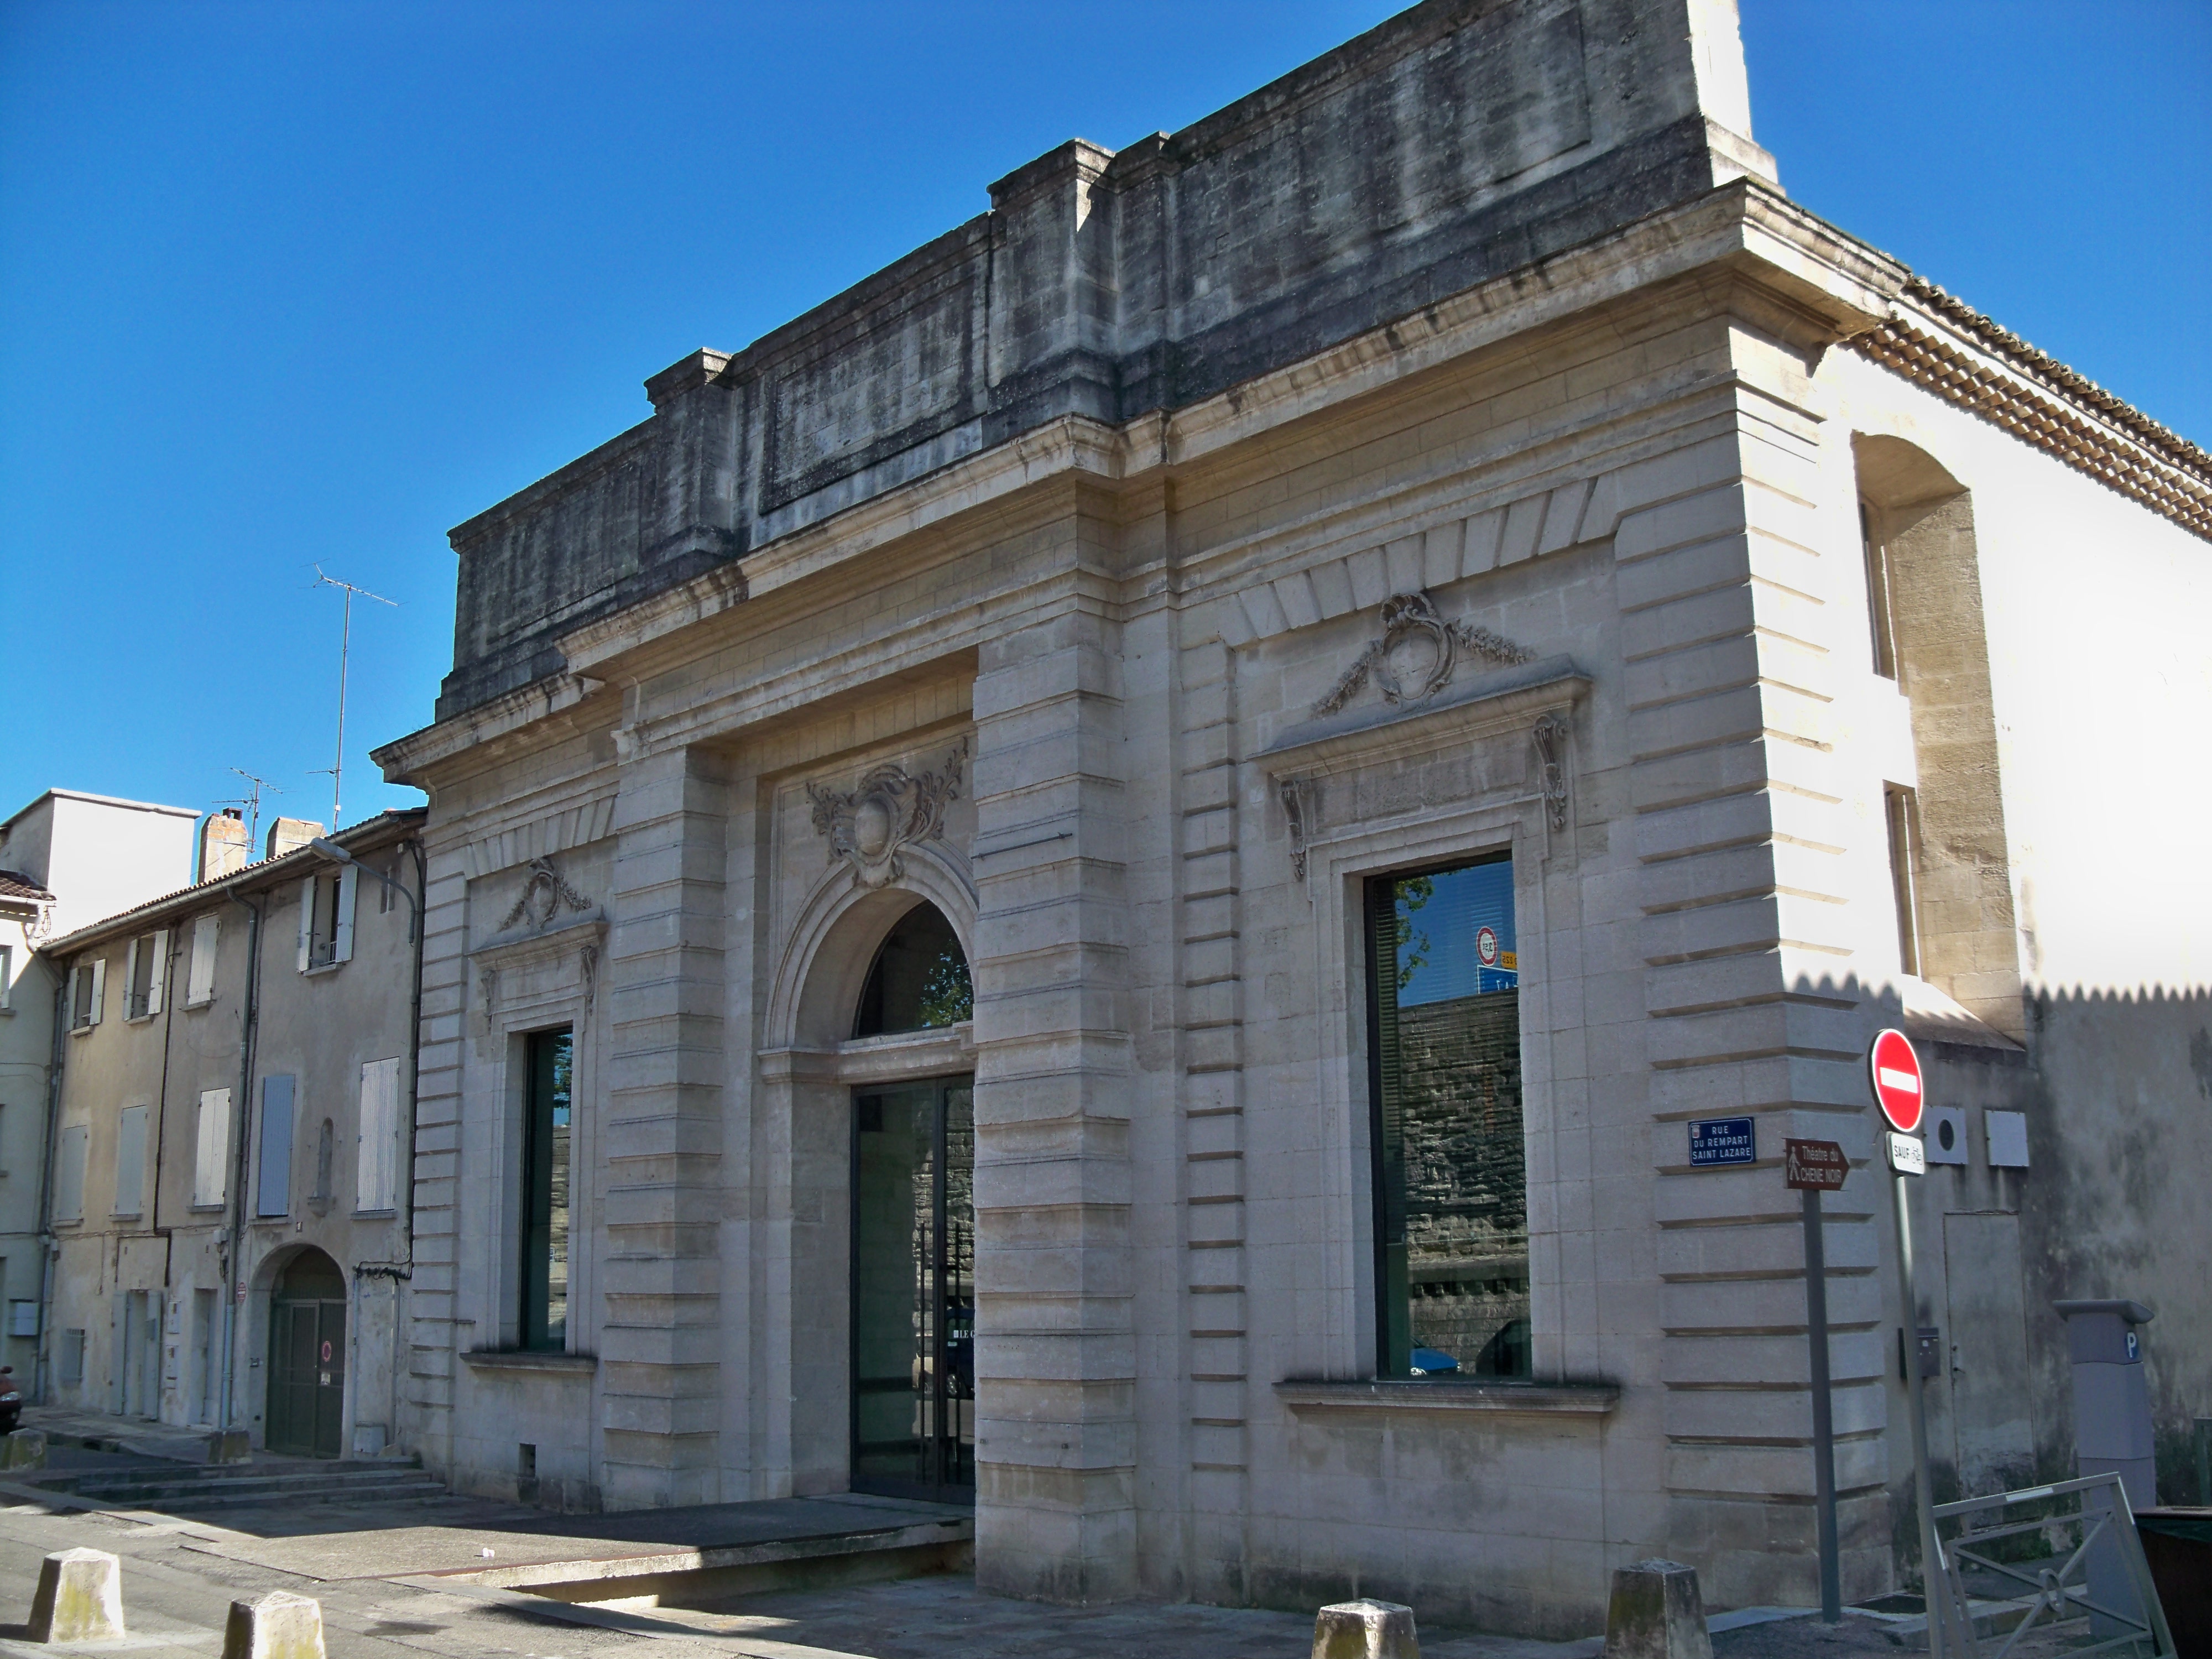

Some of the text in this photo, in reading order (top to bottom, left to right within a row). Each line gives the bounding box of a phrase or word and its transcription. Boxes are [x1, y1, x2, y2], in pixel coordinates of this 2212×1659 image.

[1712, 1126, 1728, 1134] RUE
[1708, 1136, 1747, 1146] REMPART
[1692, 1147, 1751, 1159] SAINT LAZARE
[1830, 1148, 1838, 1161] du
[1894, 1145, 1909, 1159] SAUF
[1801, 1167, 1841, 1183] CHENE NOIR
[2127, 1332, 2136, 1358] P
